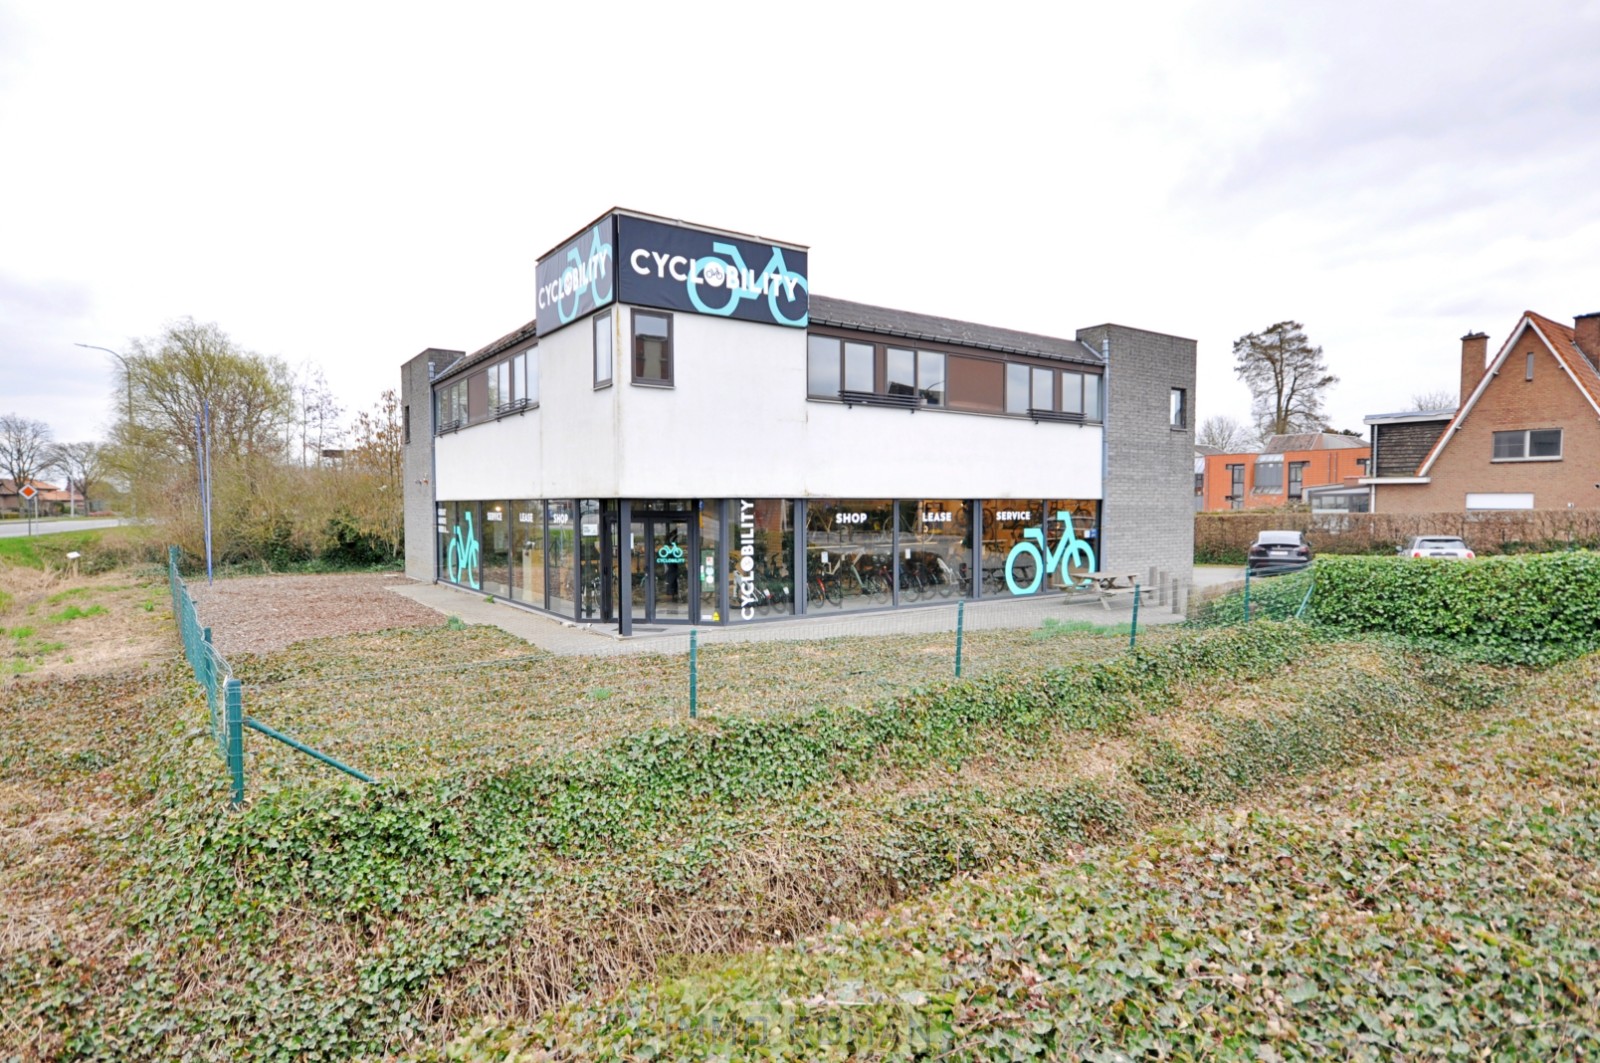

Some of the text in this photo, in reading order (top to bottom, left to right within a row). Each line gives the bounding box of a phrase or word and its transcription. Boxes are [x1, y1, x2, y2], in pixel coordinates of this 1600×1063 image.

[630, 248, 799, 300] CYCLOBILITY
[538, 250, 608, 310] CYCLOBILITY
[519, 512, 533, 523] LEASE
[553, 513, 568, 524] SHOP
[835, 512, 867, 524] SHOP
[922, 512, 952, 522] LEASE
[996, 511, 1031, 521] SERVICE
[740, 499, 754, 620] CYCLOBILITY
